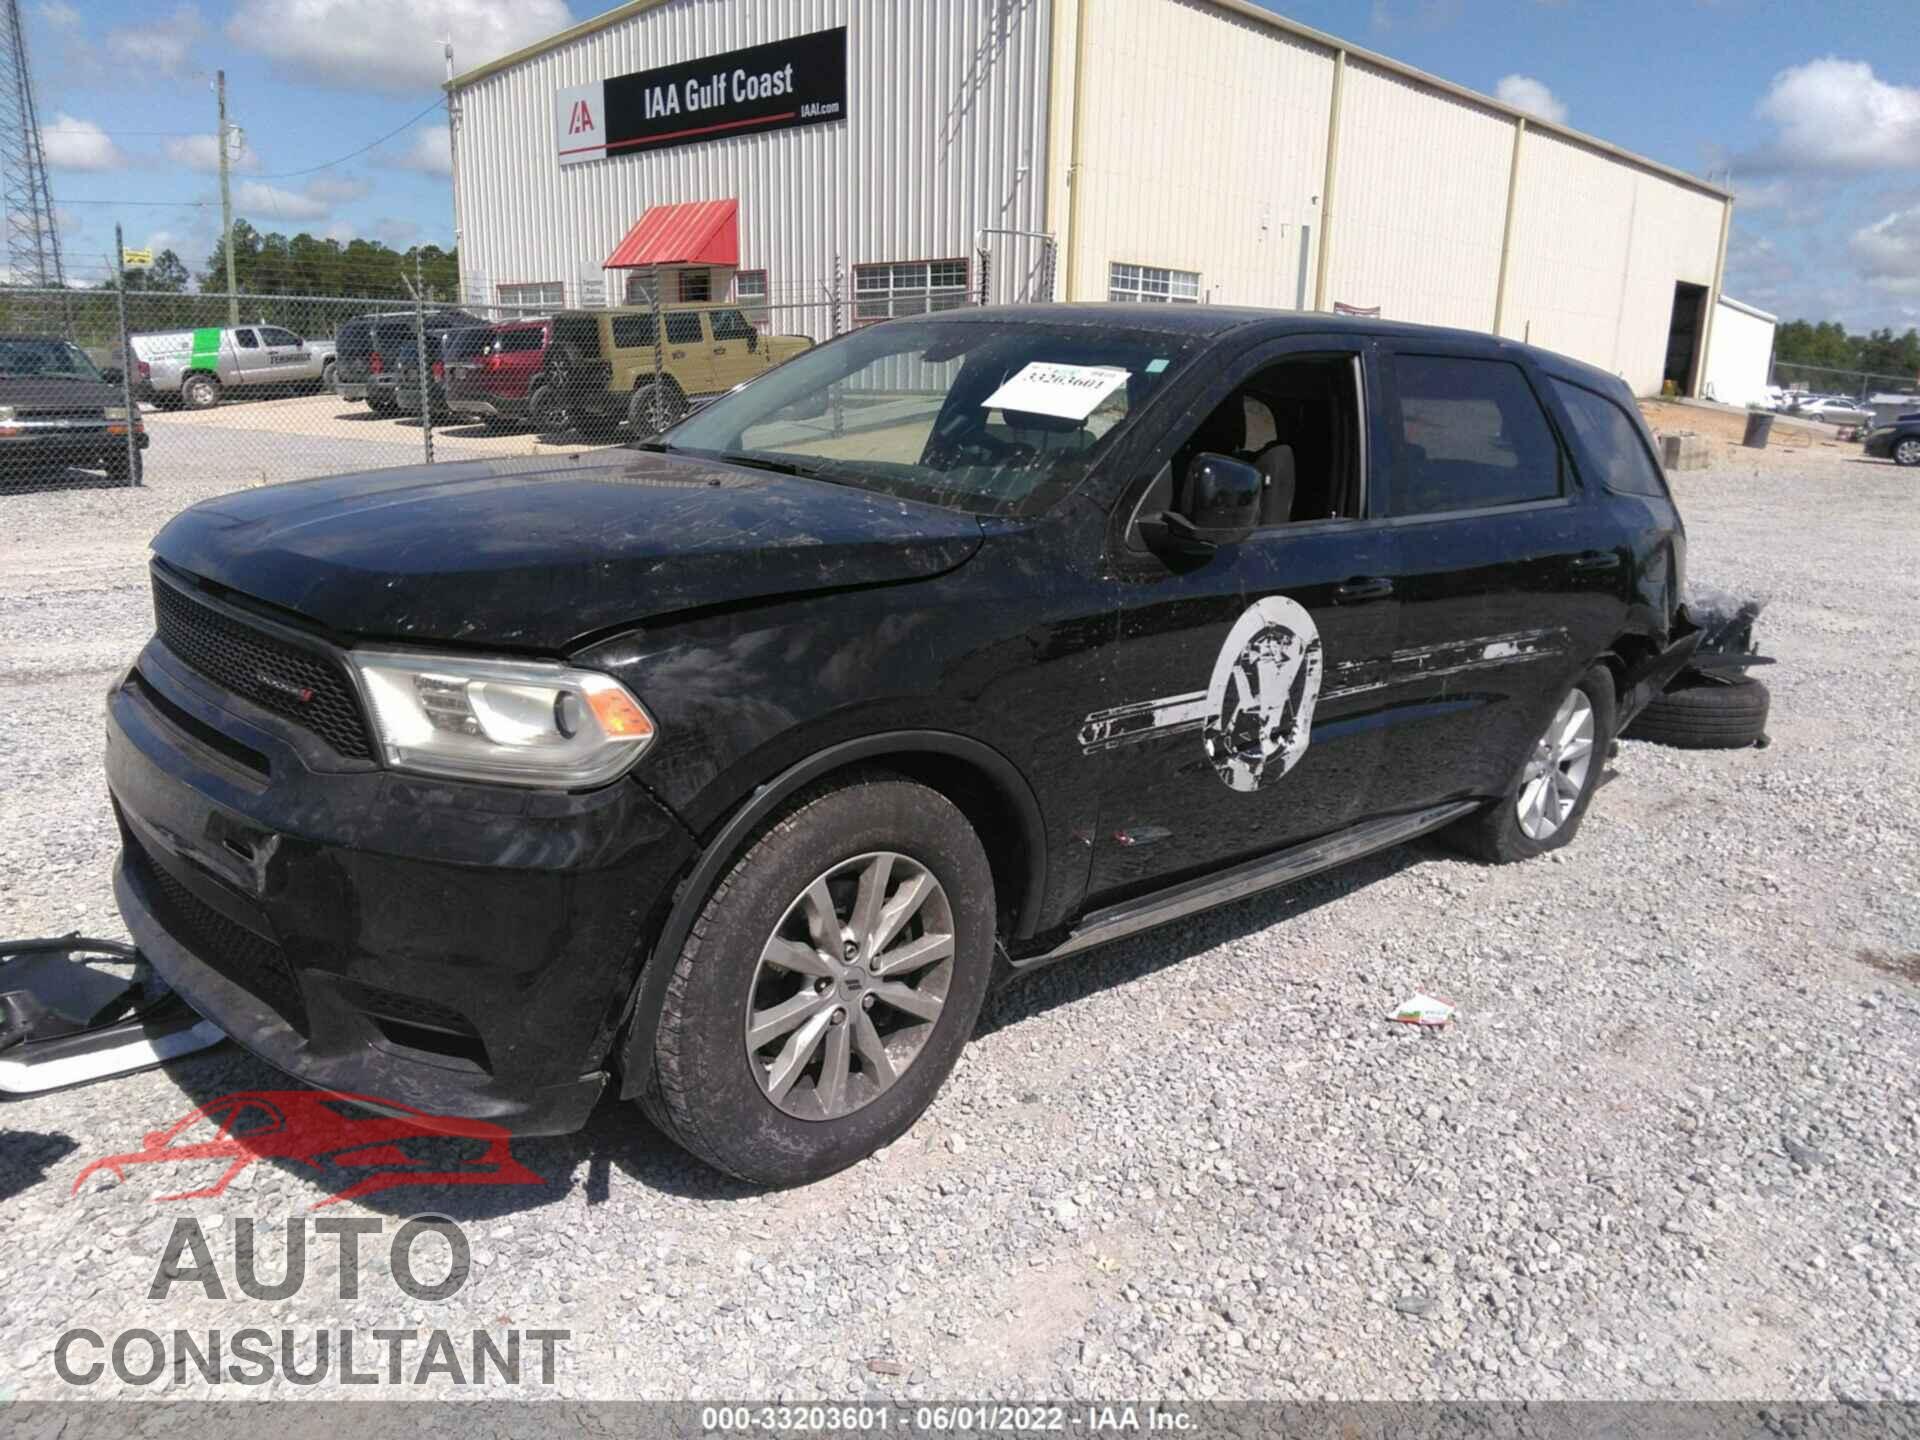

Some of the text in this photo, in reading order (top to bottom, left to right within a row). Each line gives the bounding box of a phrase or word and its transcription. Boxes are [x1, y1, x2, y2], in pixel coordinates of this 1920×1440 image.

[644, 63, 794, 120] IAA Gulf Coast
